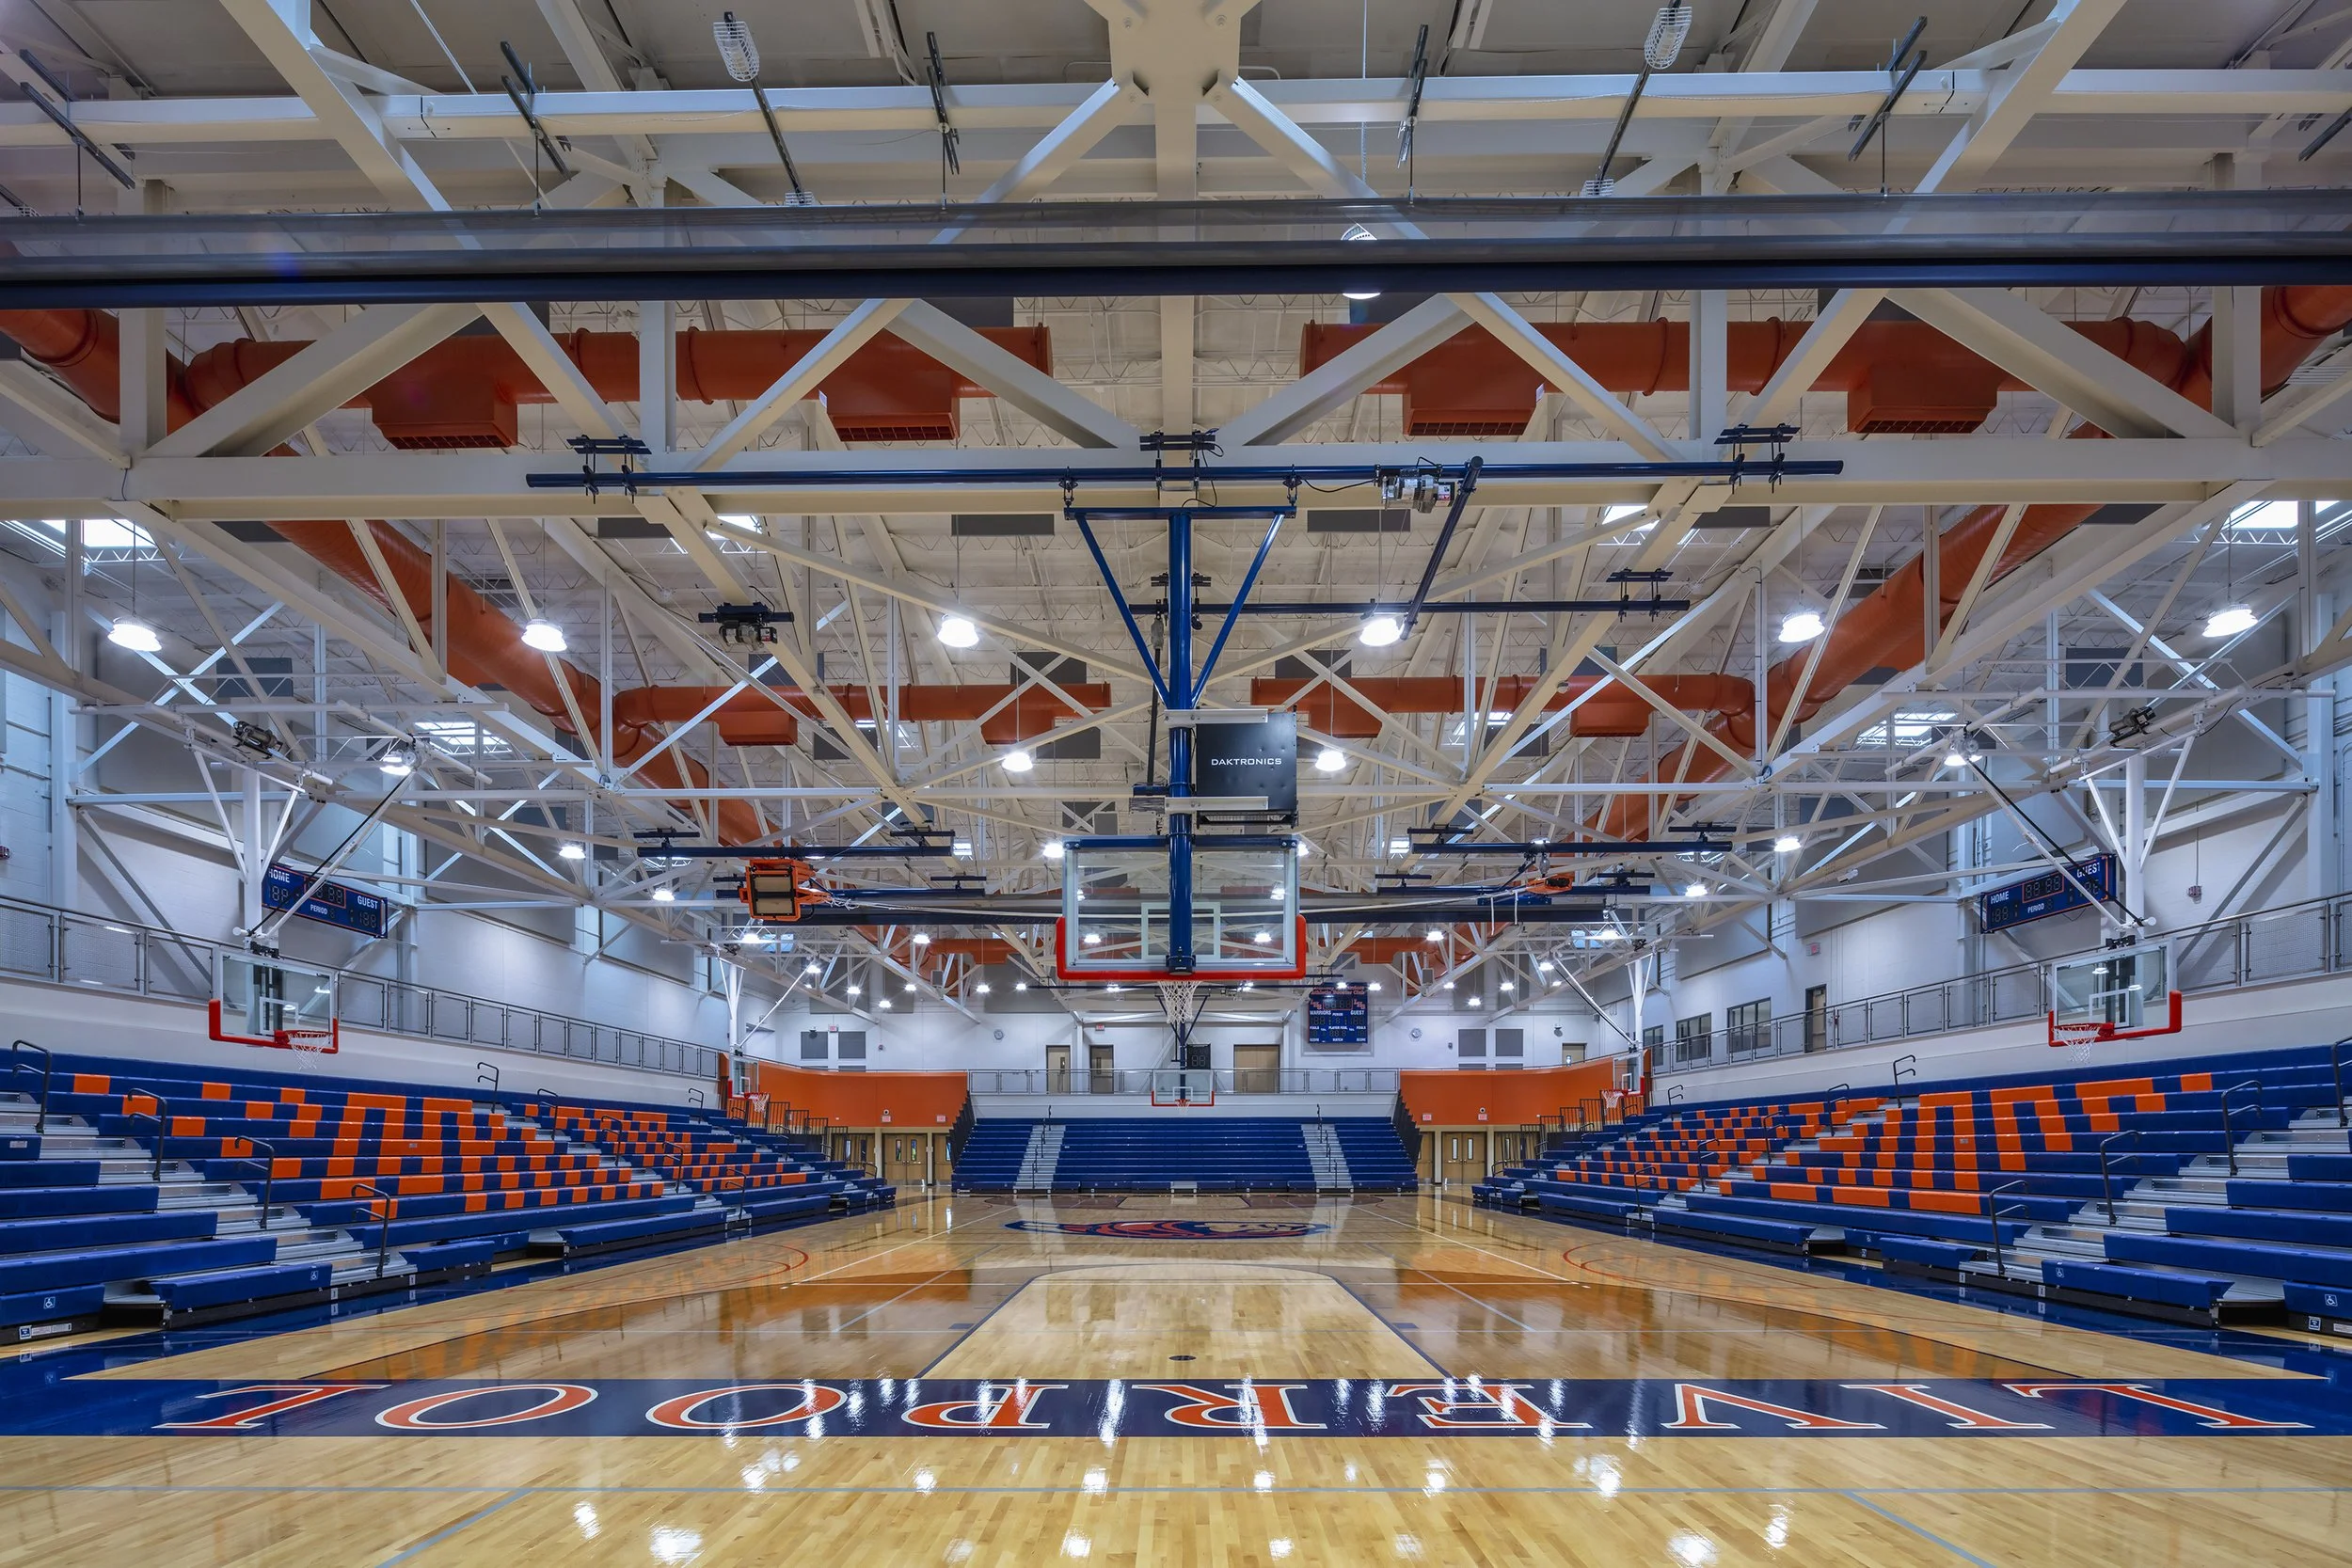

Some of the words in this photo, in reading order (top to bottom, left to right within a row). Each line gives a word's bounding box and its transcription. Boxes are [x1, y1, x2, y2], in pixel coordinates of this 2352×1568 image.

[268, 869, 291, 883] HOME
[357, 895, 379, 910] GUEST
[1990, 891, 2010, 905] HOME
[310, 904, 328, 915] PERIOD
[2027, 902, 2045, 913] PERIOD
[152, 1382, 2315, 1432] LIVERPOOL
